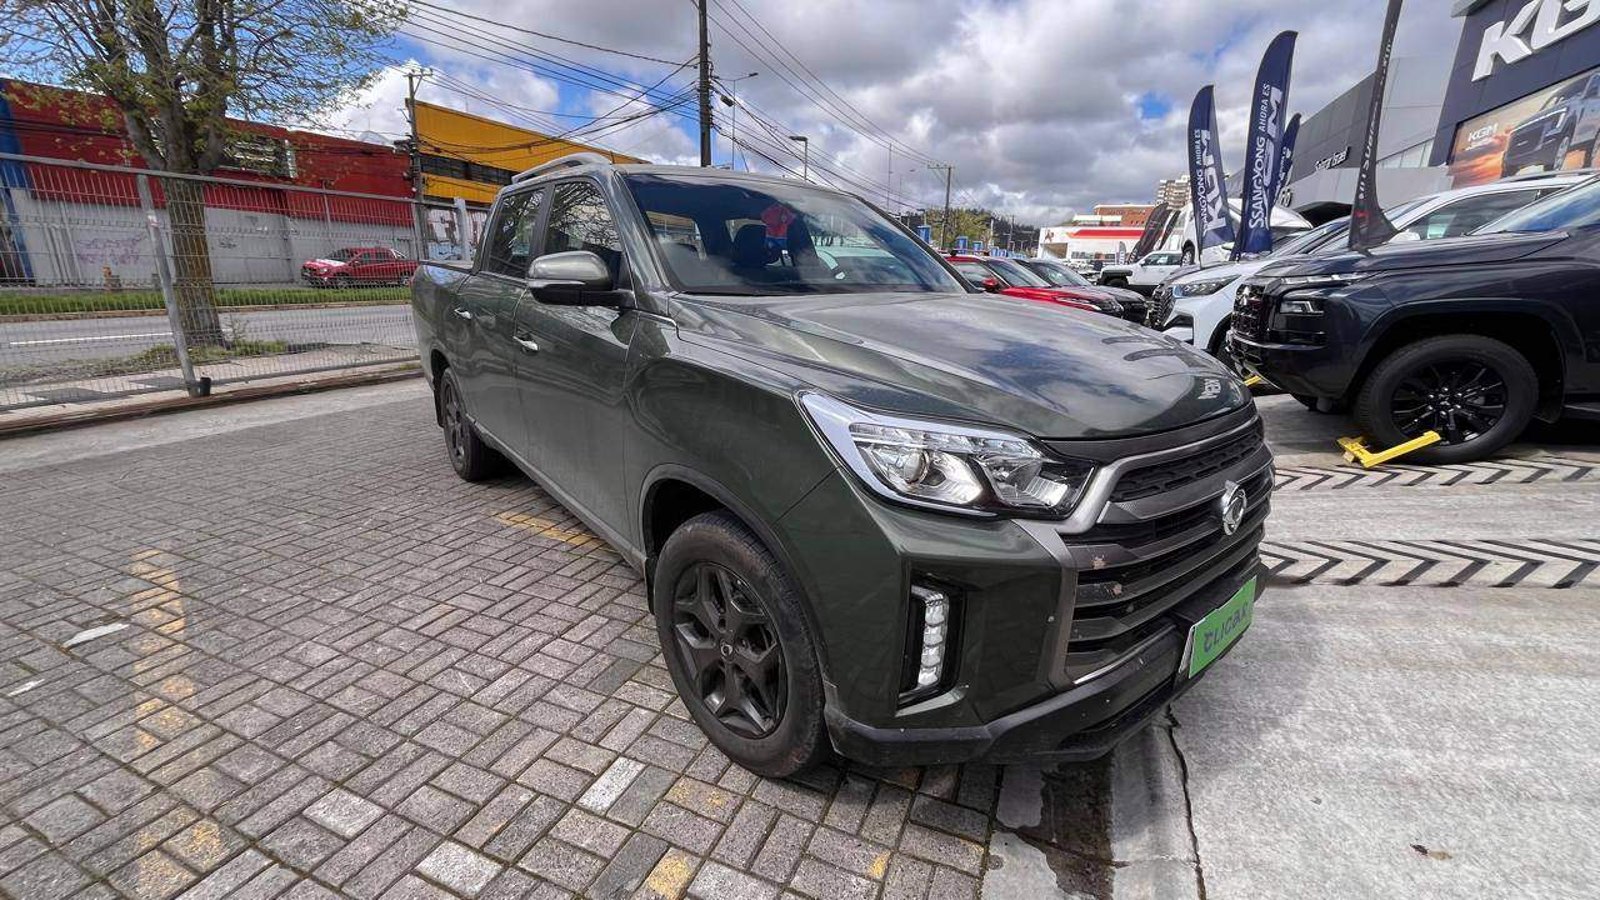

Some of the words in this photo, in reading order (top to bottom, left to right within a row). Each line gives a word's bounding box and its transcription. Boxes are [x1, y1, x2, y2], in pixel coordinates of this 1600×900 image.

[1258, 99, 1269, 132] AHORA
[1262, 84, 1271, 95] ES
[1201, 130, 1227, 231] KGM
[1249, 137, 1265, 229] SSANGYONG
